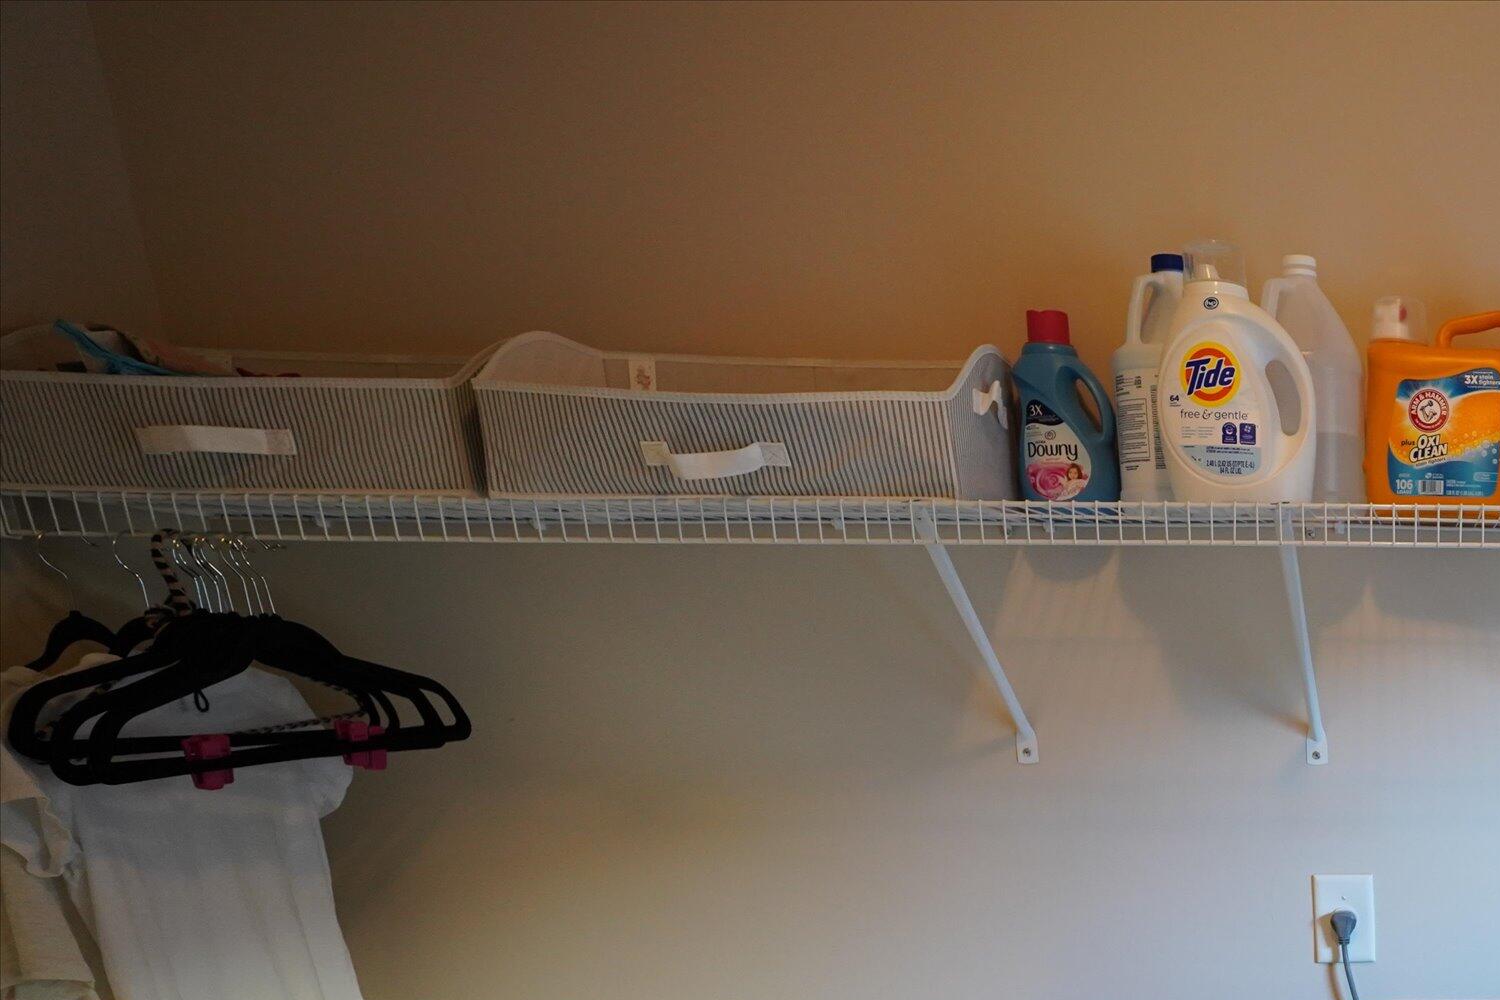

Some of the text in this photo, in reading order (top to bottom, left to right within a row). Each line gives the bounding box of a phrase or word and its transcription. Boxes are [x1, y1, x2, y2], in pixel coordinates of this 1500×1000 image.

[1185, 358, 1236, 396] Tide
[1464, 374, 1478, 385] 3X
[1029, 404, 1043, 416] 3X
[1180, 409, 1248, 421] free & gentle
[1401, 434, 1440, 448] plus OXI
[1027, 442, 1079, 461] Downy
[1409, 443, 1448, 462] CLEAN
[1396, 479, 1413, 490] 106
